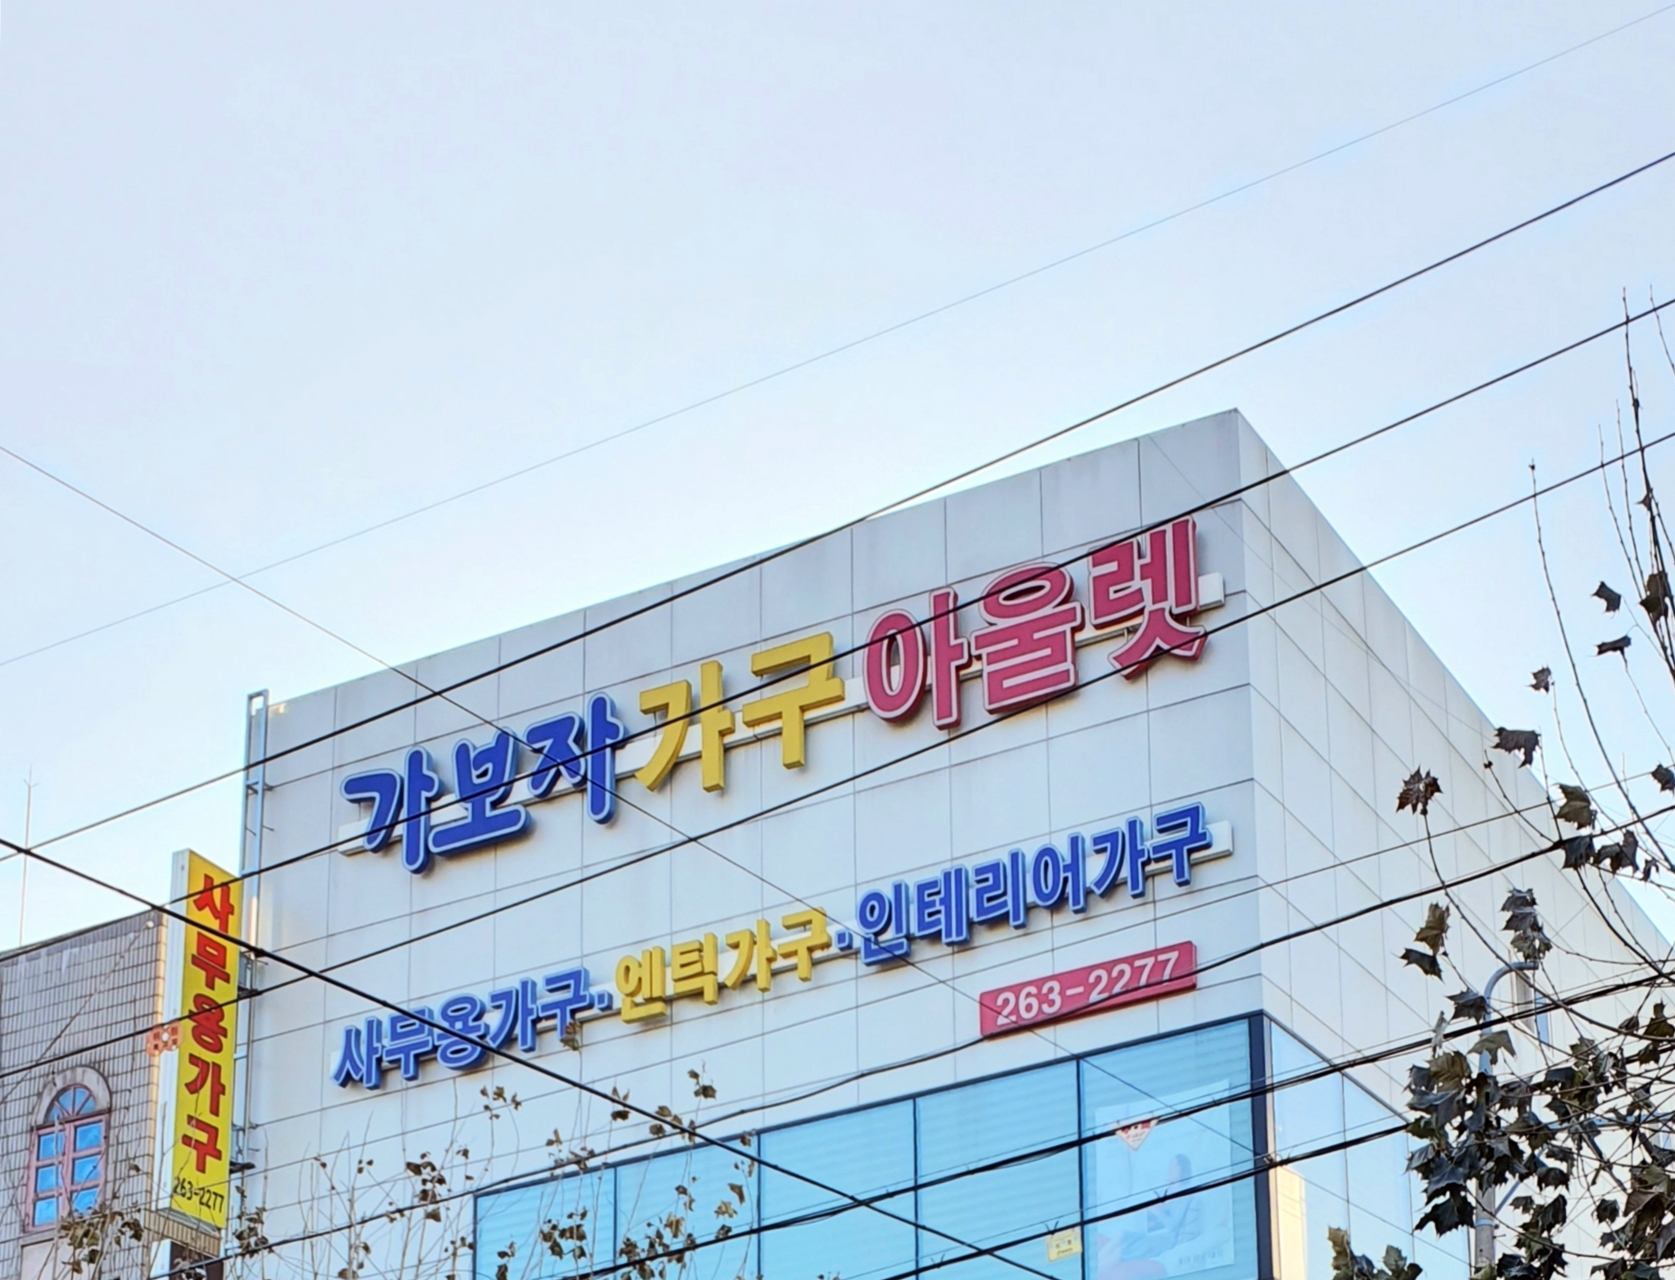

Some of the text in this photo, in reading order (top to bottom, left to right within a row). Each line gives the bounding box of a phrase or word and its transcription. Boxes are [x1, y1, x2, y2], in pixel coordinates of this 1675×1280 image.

[340, 516, 1207, 875] 가보자 가구 아울렛
[181, 873, 235, 1174] 사무용가구
[996, 950, 1180, 1026] 263-2277
[173, 1176, 225, 1215] 263-2277
